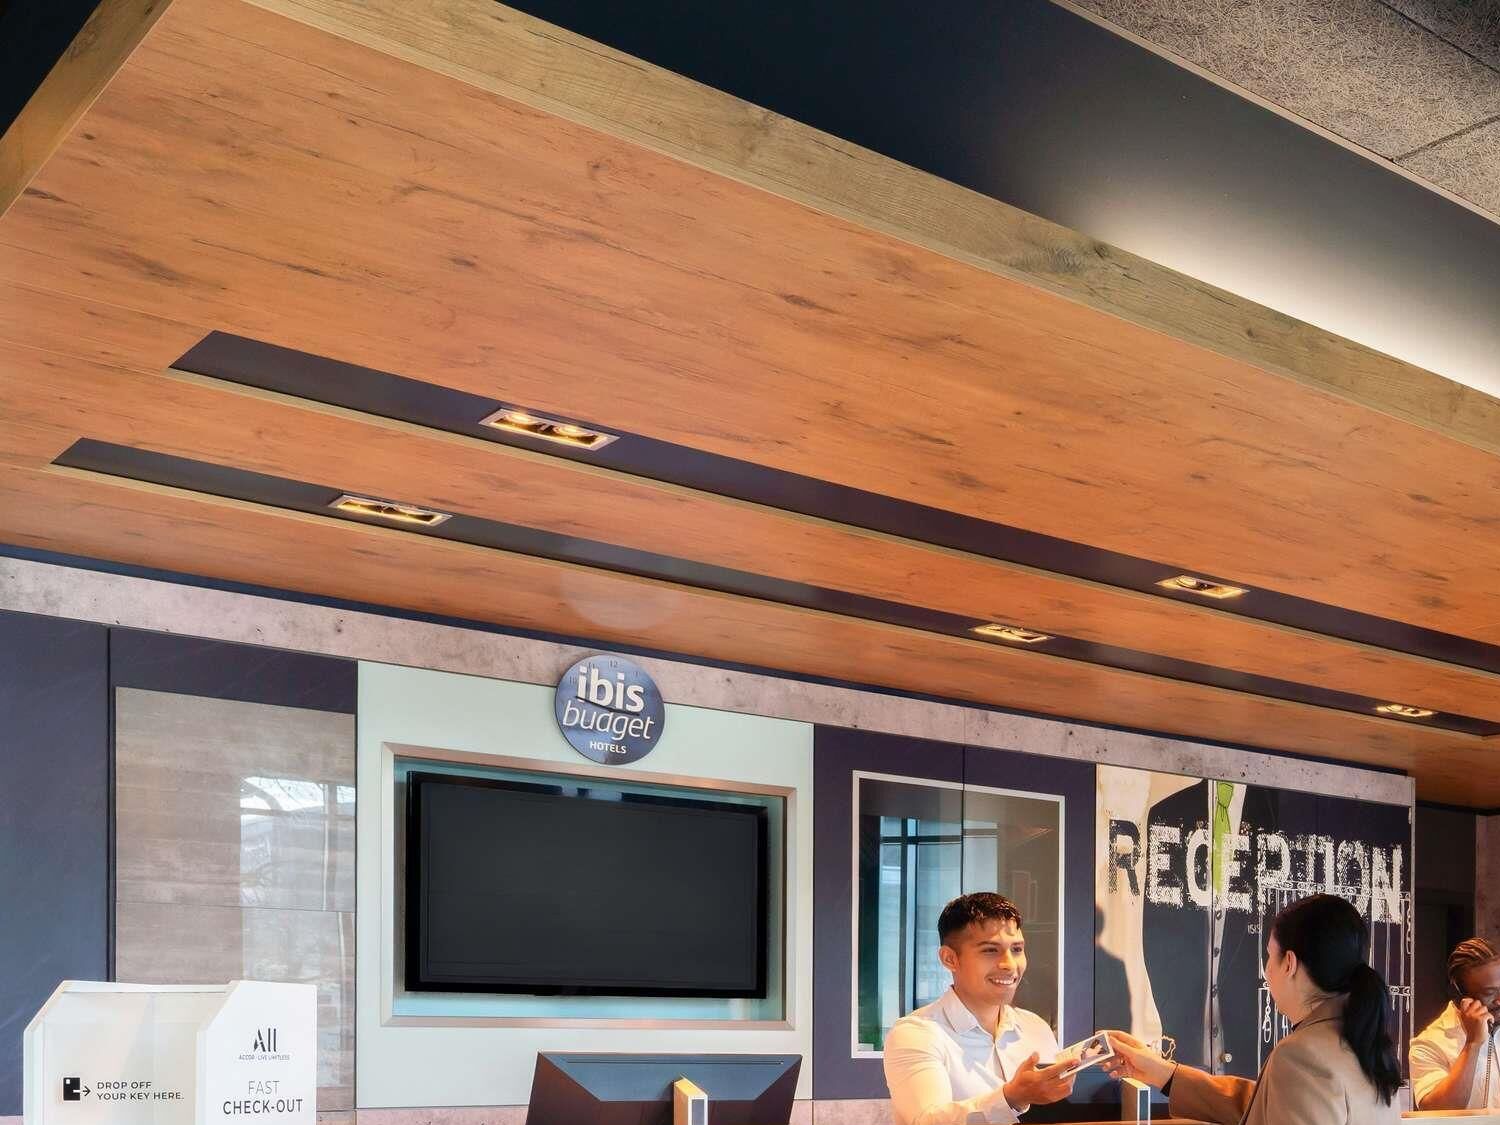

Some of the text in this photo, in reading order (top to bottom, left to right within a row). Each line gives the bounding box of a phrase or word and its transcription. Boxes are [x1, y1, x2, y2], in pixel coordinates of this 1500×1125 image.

[577, 666, 644, 712] ibis
[562, 700, 655, 740] budget
[590, 741, 627, 753] HOTELS
[1108, 818, 1403, 925] RECEPTION
[97, 1081, 152, 1090] DROP OFF
[248, 1080, 280, 1094] FAST
[97, 1091, 184, 1101] YOUR KEY HERE.
[223, 1098, 303, 1115] CHECK-OUT
